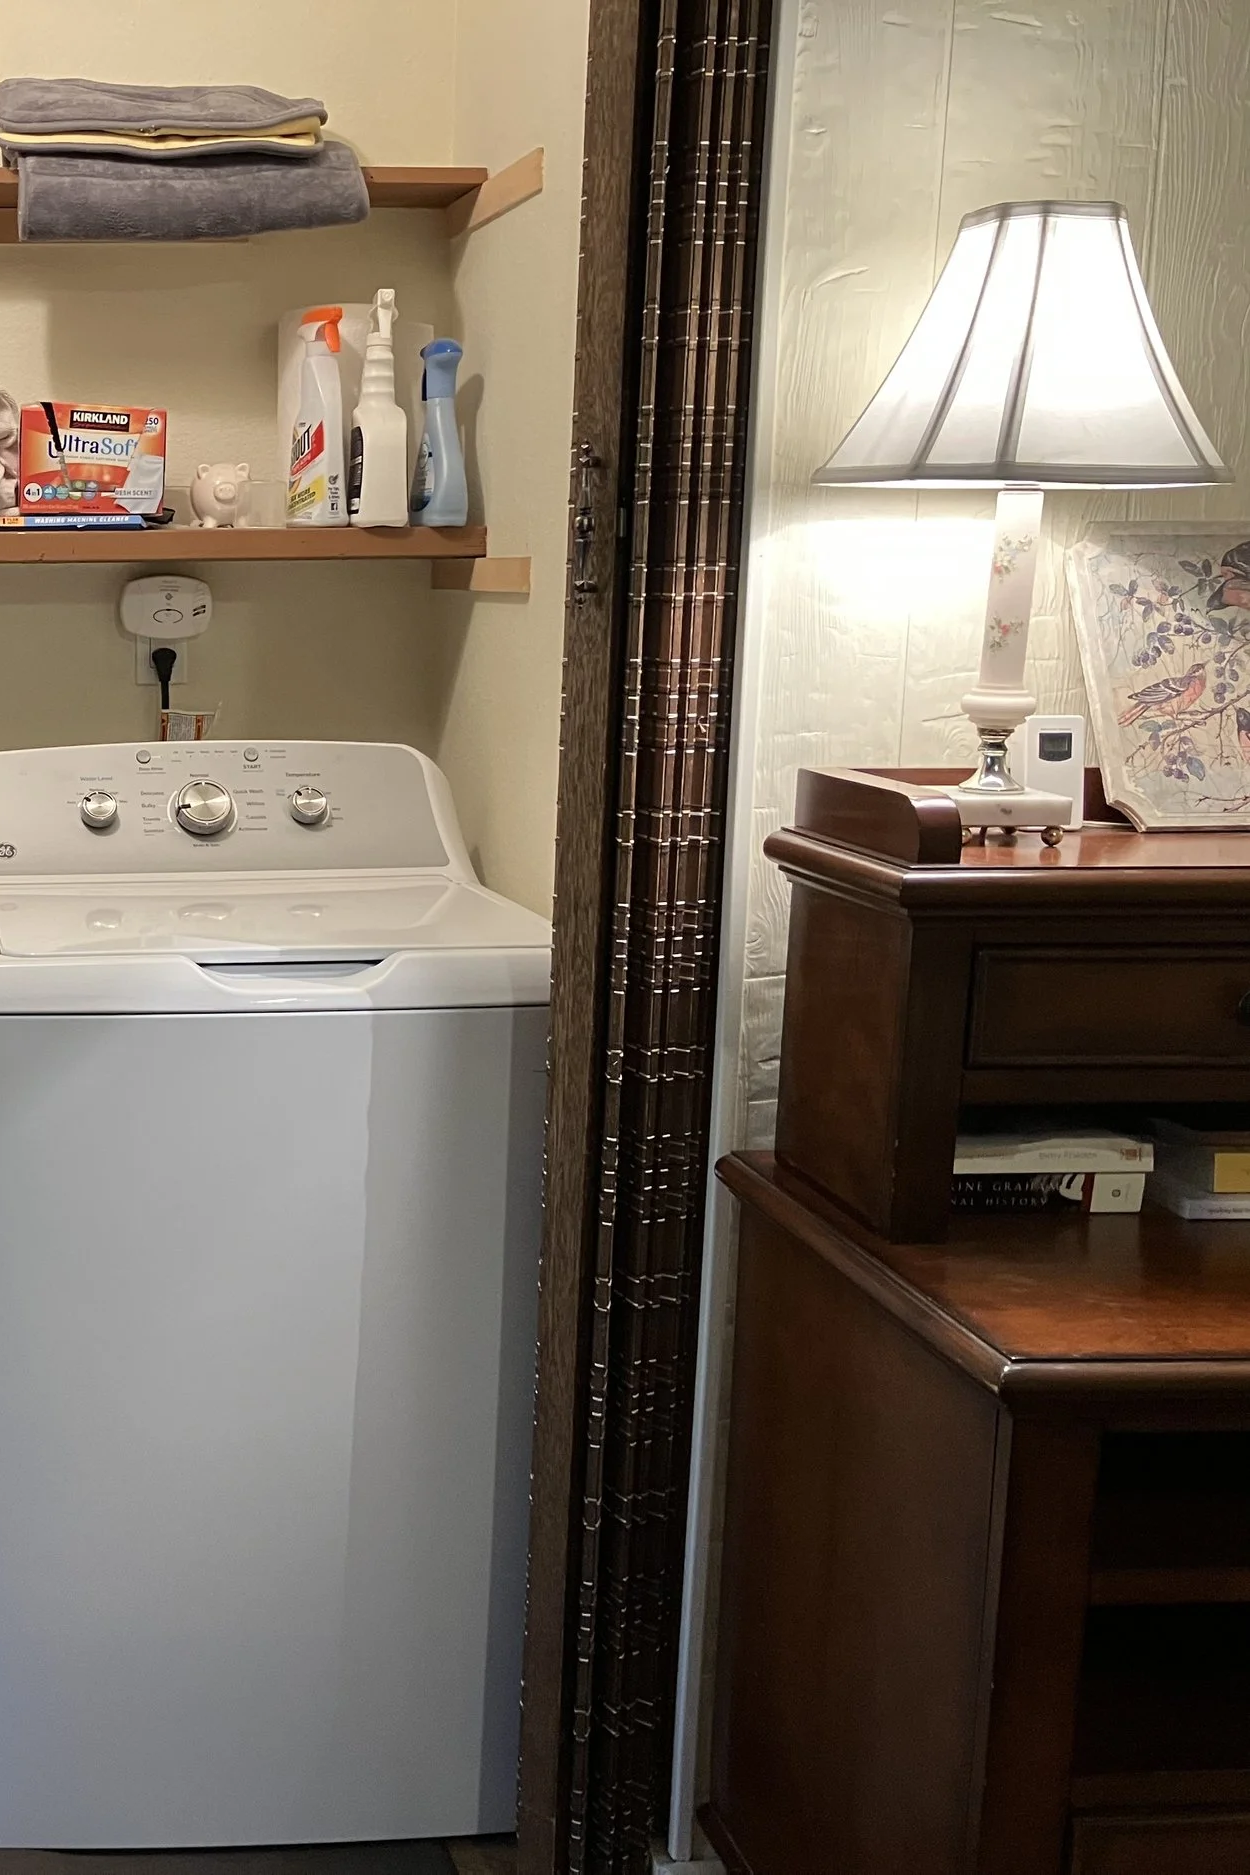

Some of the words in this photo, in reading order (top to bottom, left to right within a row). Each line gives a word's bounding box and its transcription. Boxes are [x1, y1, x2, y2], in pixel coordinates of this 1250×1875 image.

[73, 412, 128, 425] KIRKLAND
[952, 1182, 982, 1191] INE
[986, 1197, 1048, 1206] HISTORY
